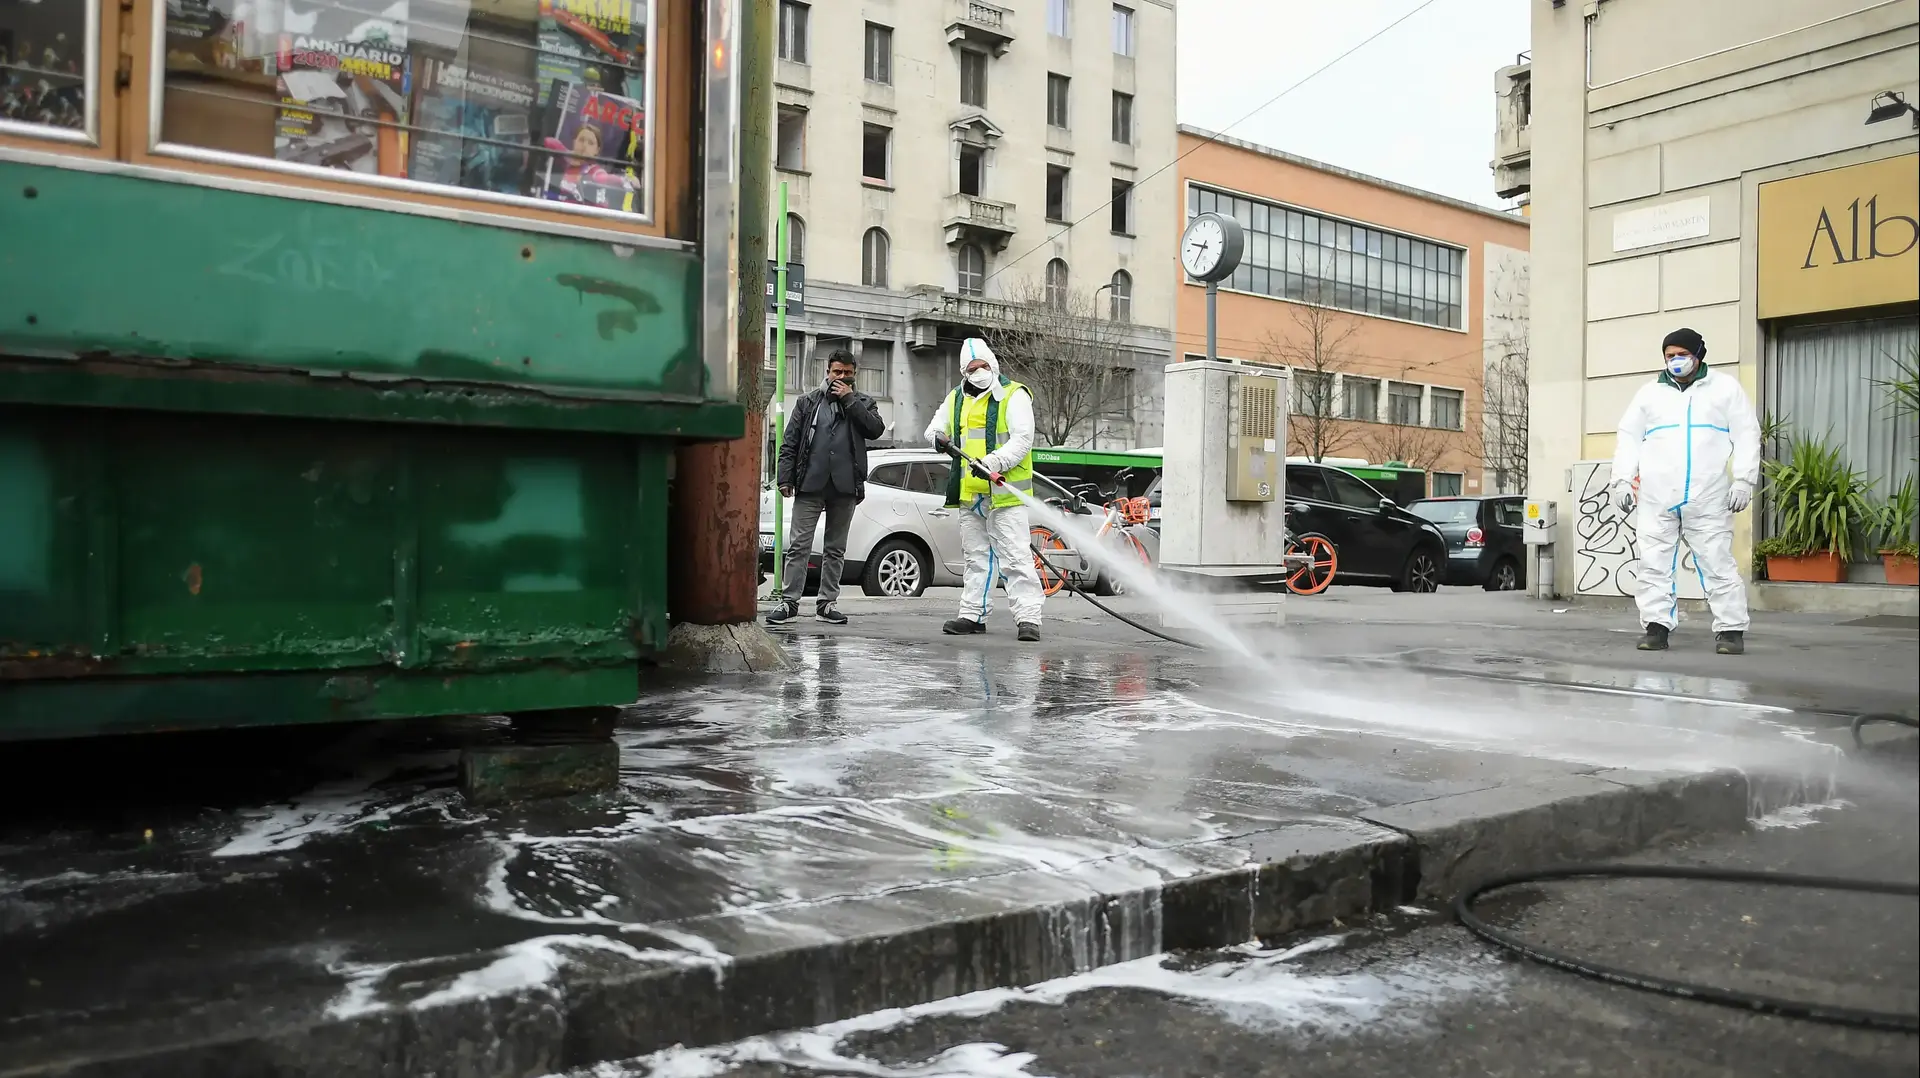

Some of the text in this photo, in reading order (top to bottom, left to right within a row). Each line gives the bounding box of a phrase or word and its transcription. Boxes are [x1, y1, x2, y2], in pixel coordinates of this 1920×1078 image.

[294, 36, 402, 65] ANNUARIO
[294, 49, 340, 69] 2020
[1801, 194, 1920, 269] Alb
